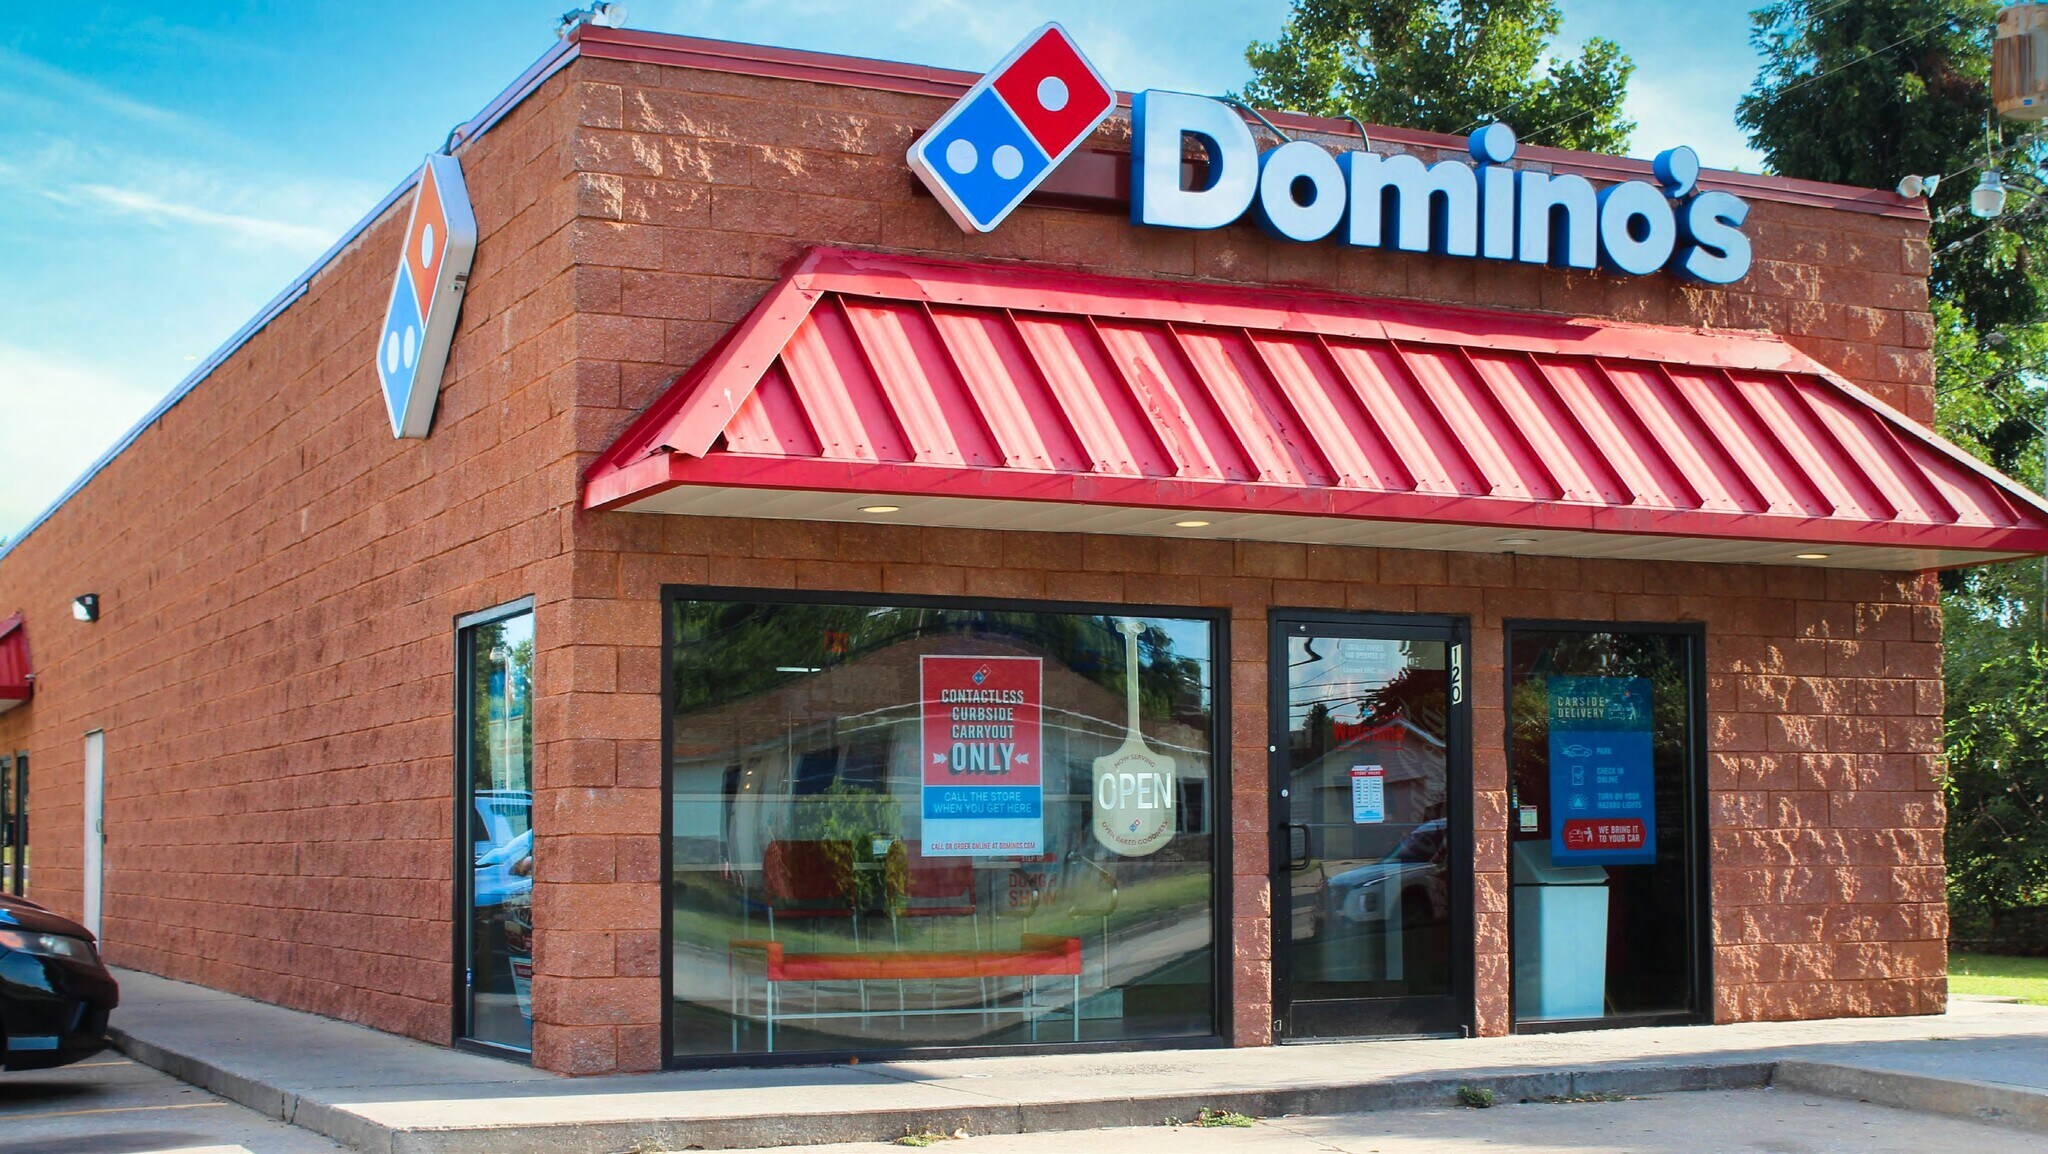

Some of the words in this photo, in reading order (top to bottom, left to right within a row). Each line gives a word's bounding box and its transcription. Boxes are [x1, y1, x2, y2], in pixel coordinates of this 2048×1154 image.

[1132, 89, 1752, 285] Domino's
[1452, 648, 1461, 702] 120
[941, 689, 1024, 704] CONTACTLESS
[1557, 697, 1604, 707] CARSIDE
[952, 707, 1014, 721] CURBSIDE
[1558, 708, 1604, 718] DELIVERY
[952, 725, 1014, 739] CARRYOUT
[1332, 723, 1405, 742] Welcome
[950, 742, 1015, 773] ONLY
[1114, 754, 1130, 769] NOW
[1130, 753, 1156, 769] SERVING
[1596, 767, 1616, 775] CHECK
[944, 791, 968, 802] CALL
[970, 791, 989, 801] THE
[990, 791, 1022, 801] STORE
[1098, 772, 1172, 811] OPEN
[933, 803, 963, 814] WHEN
[964, 803, 985, 813] YOU
[986, 803, 1005, 813] GET
[1007, 803, 1032, 813] HERE
[1622, 801, 1642, 809] LIGHTS
[1102, 821, 1116, 839] OVEN
[1115, 836, 1137, 846] BAKED
[1138, 821, 1168, 846] GOODNESS
[1598, 825, 1610, 834] WE
[1610, 825, 1631, 834] BRING
[1632, 825, 1639, 834] IT
[1598, 834, 1607, 843] TO
[1609, 834, 1626, 843] YOUR
[1627, 834, 1640, 843] CAR
[972, 842, 990, 850] ONLINE
